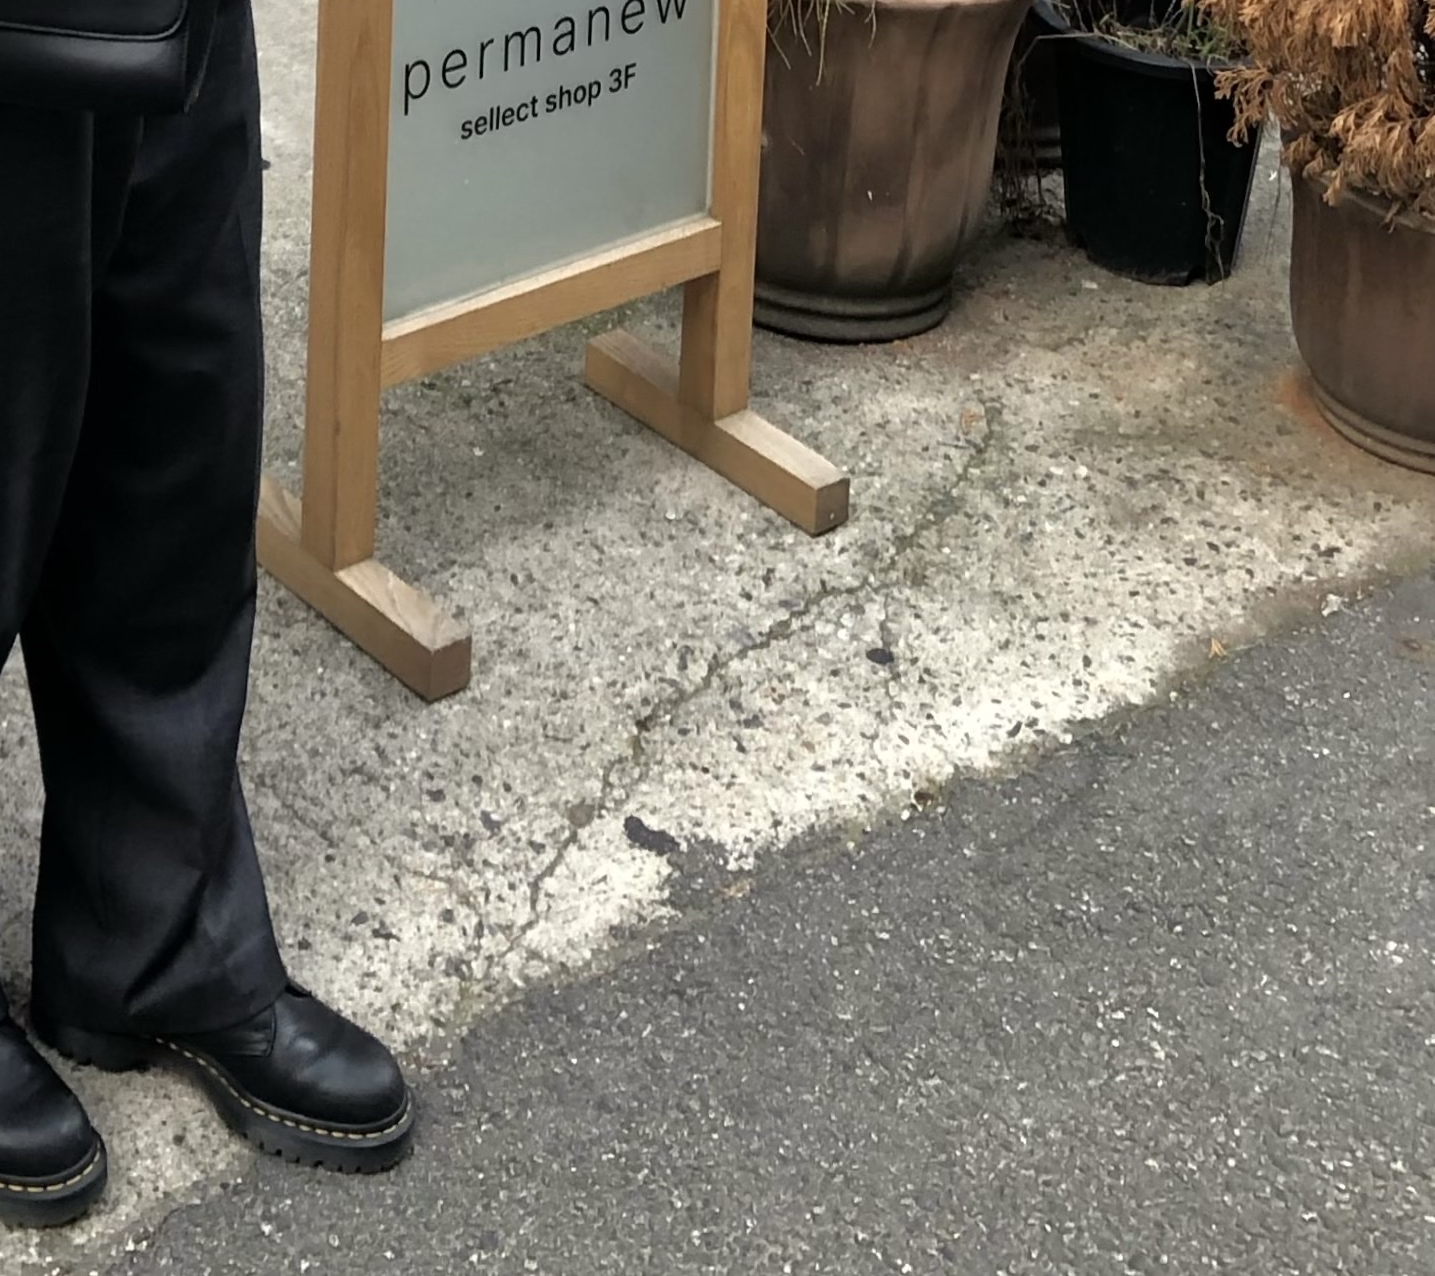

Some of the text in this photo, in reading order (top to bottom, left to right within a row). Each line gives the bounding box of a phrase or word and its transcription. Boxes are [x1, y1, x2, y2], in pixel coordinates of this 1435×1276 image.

[460, 63, 637, 140] sellect shop 3F
